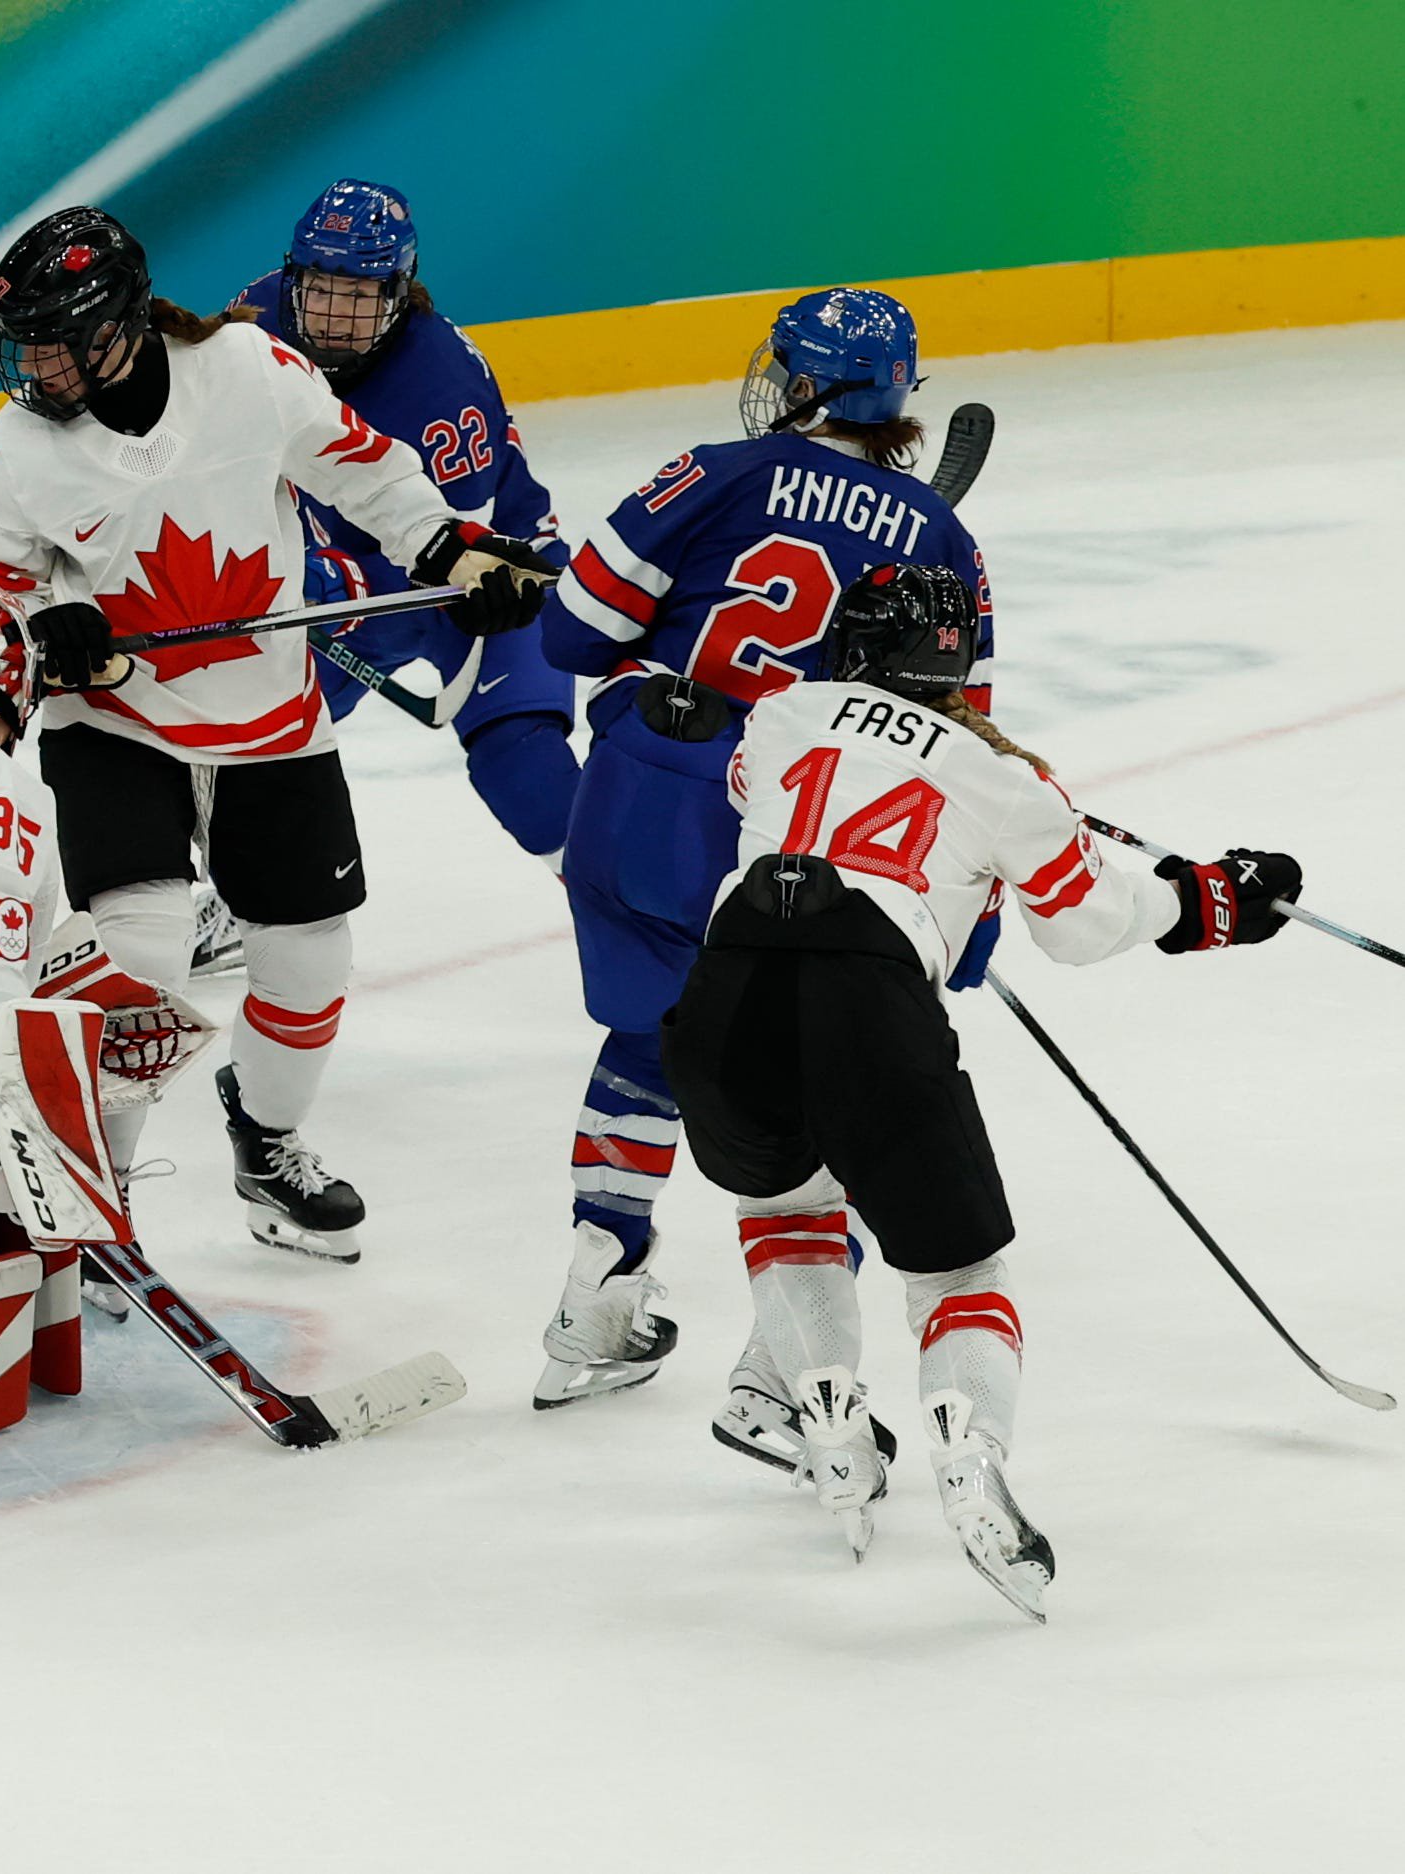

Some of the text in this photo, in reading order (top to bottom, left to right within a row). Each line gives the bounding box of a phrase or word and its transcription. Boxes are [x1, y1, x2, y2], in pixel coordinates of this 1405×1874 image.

[322, 212, 354, 234] 22
[71, 290, 109, 316] BAUER
[800, 339, 833, 355] BAUER
[421, 405, 493, 486] 22
[765, 464, 929, 557] KNIGHT
[167, 621, 227, 637] BAUER
[686, 532, 843, 707] 2
[937, 627, 960, 650] 14
[326, 641, 386, 691] BAUER
[829, 696, 950, 760] FAST
[780, 747, 945, 894] 14
[39, 938, 97, 980] CC
[10, 1128, 57, 1233] CCM
